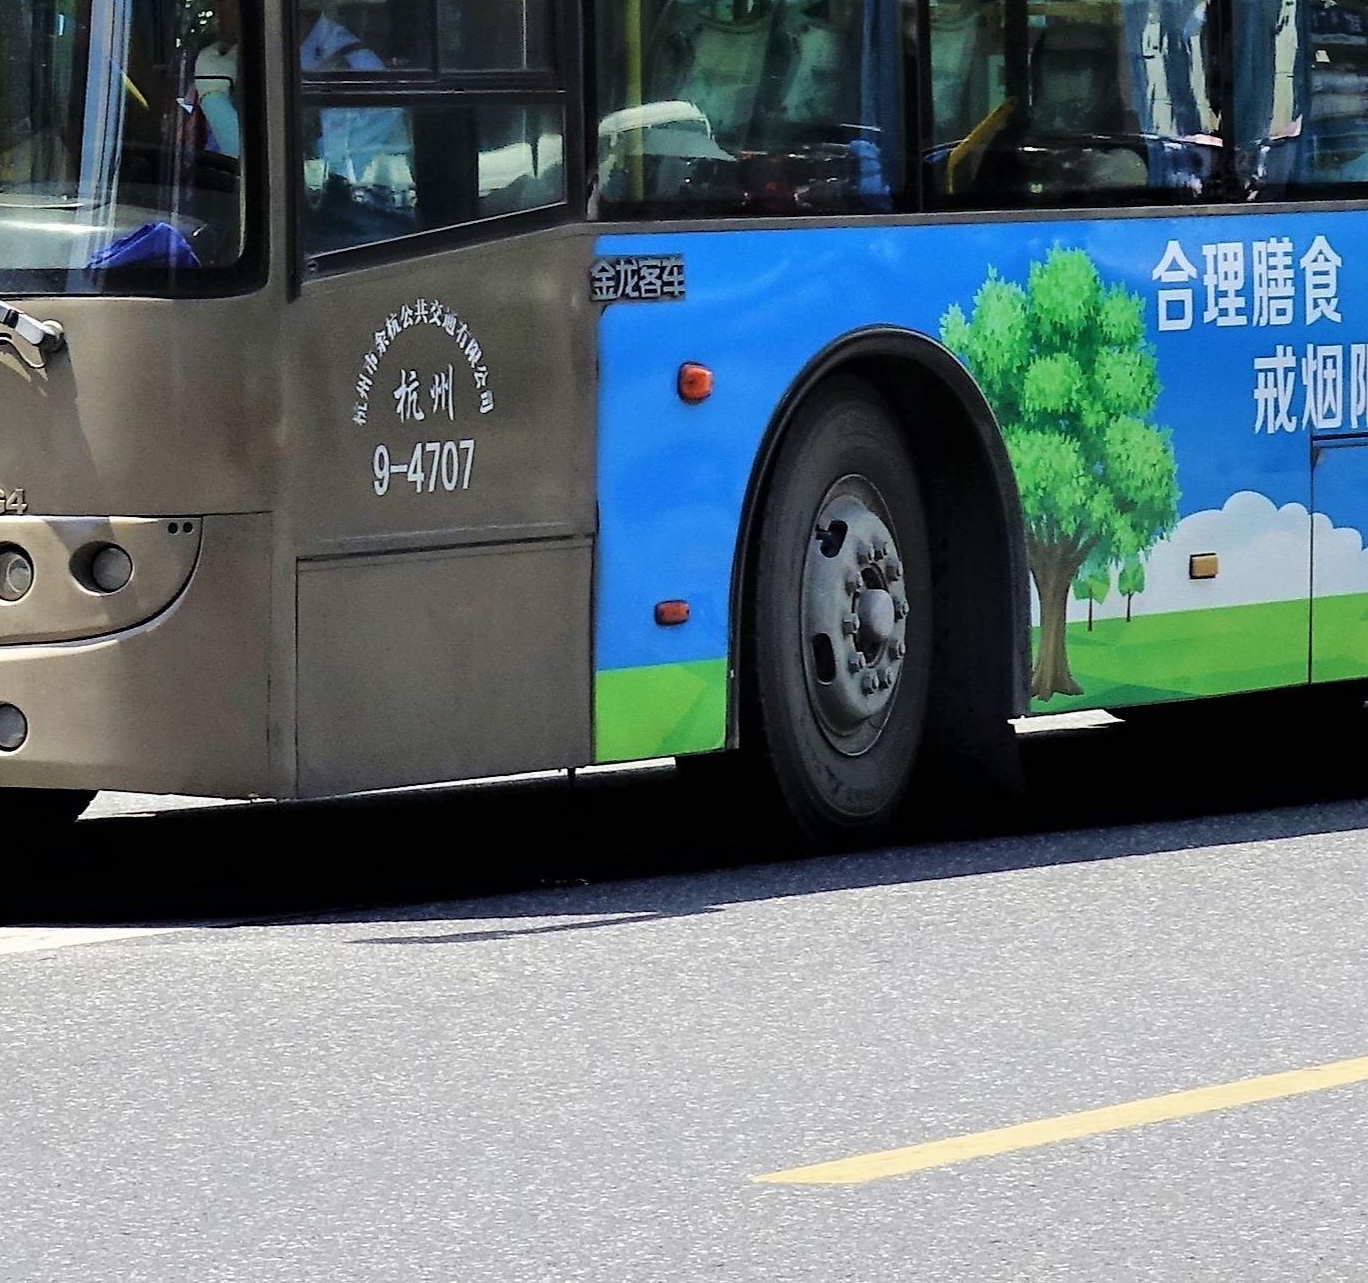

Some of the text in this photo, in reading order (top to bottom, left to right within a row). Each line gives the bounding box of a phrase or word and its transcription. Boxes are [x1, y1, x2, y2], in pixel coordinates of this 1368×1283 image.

[591, 255, 687, 302] 金龙客车
[1151, 234, 1343, 332] 合理膳食
[392, 363, 455, 423] 杭州
[373, 439, 475, 496] 9-4707
